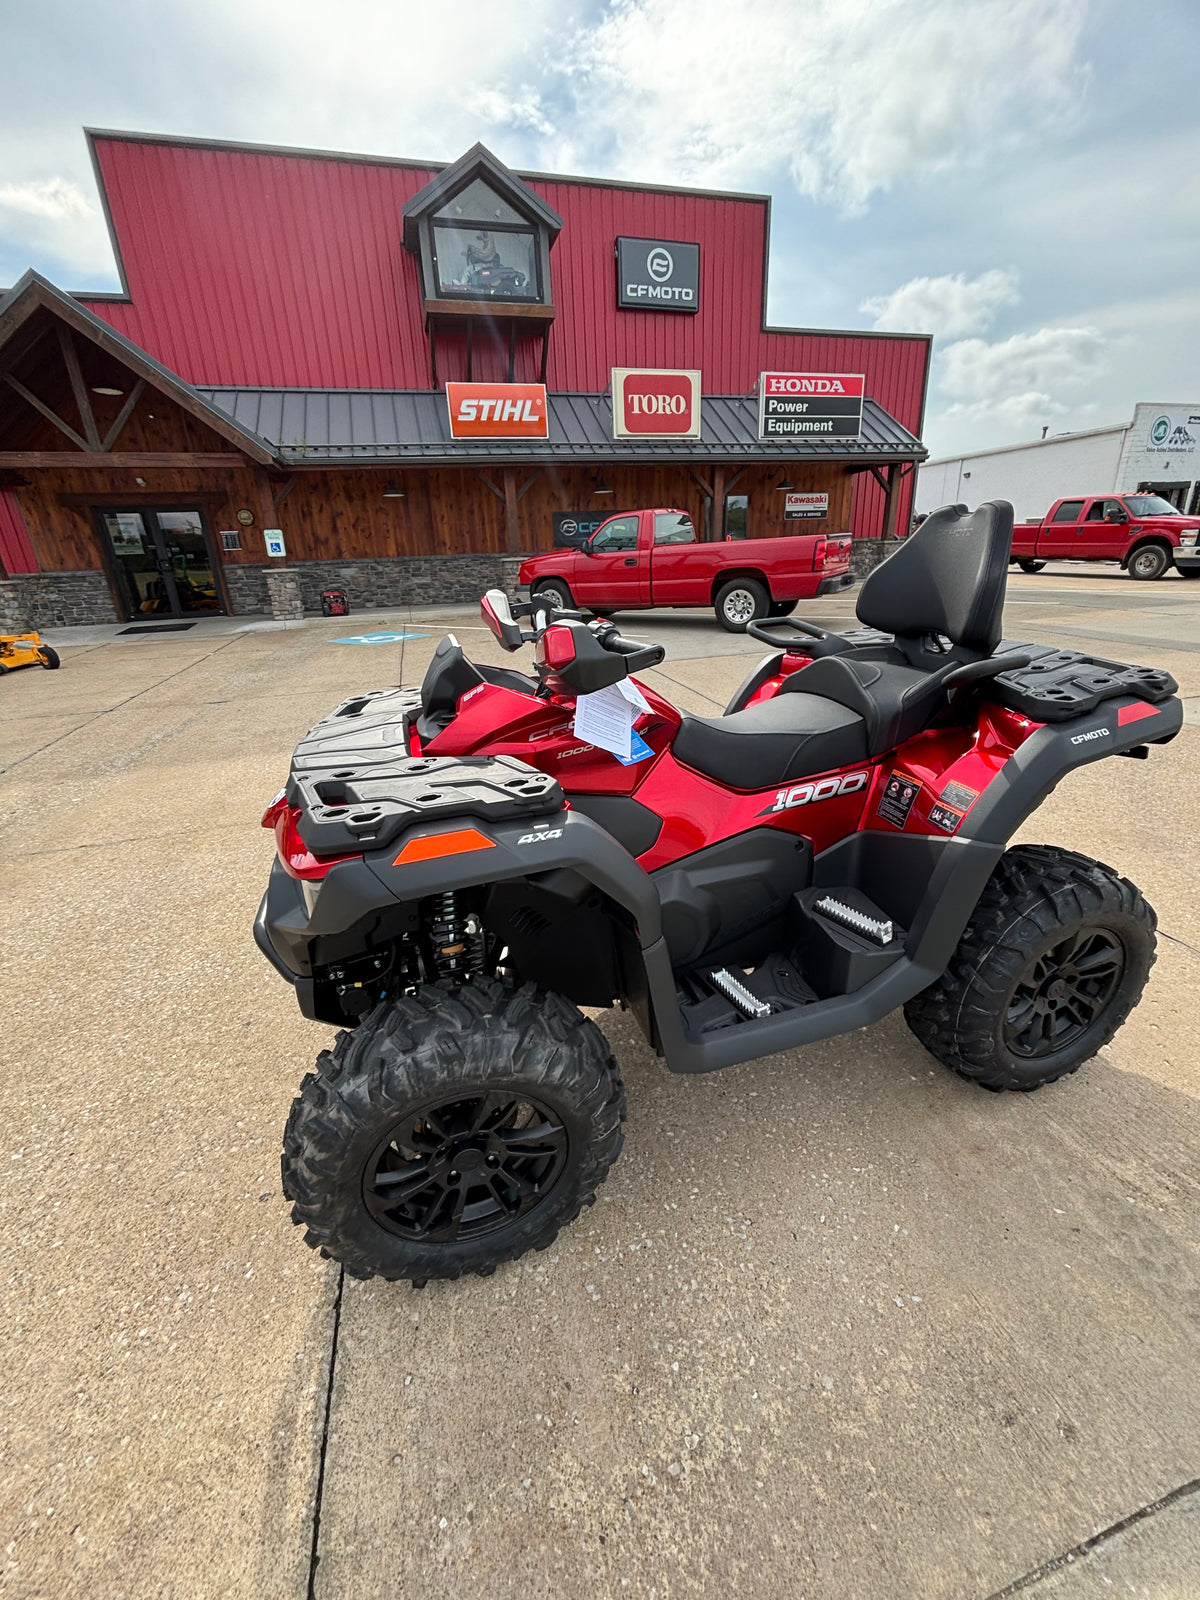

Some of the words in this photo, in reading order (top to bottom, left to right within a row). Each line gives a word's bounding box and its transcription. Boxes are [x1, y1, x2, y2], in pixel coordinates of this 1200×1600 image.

[626, 284, 694, 301] CFMOTO
[769, 378, 846, 393] HONDA
[457, 399, 540, 422] STIHL
[628, 394, 687, 415] TORO
[768, 399, 809, 413] Power
[767, 419, 834, 434] Equipment
[787, 495, 827, 503] Kawasaki
[578, 521, 604, 533] CF
[463, 684, 485, 702] EPS
[1070, 727, 1111, 745] CFMOTO
[556, 744, 594, 759] 1000
[771, 770, 870, 812] 1000
